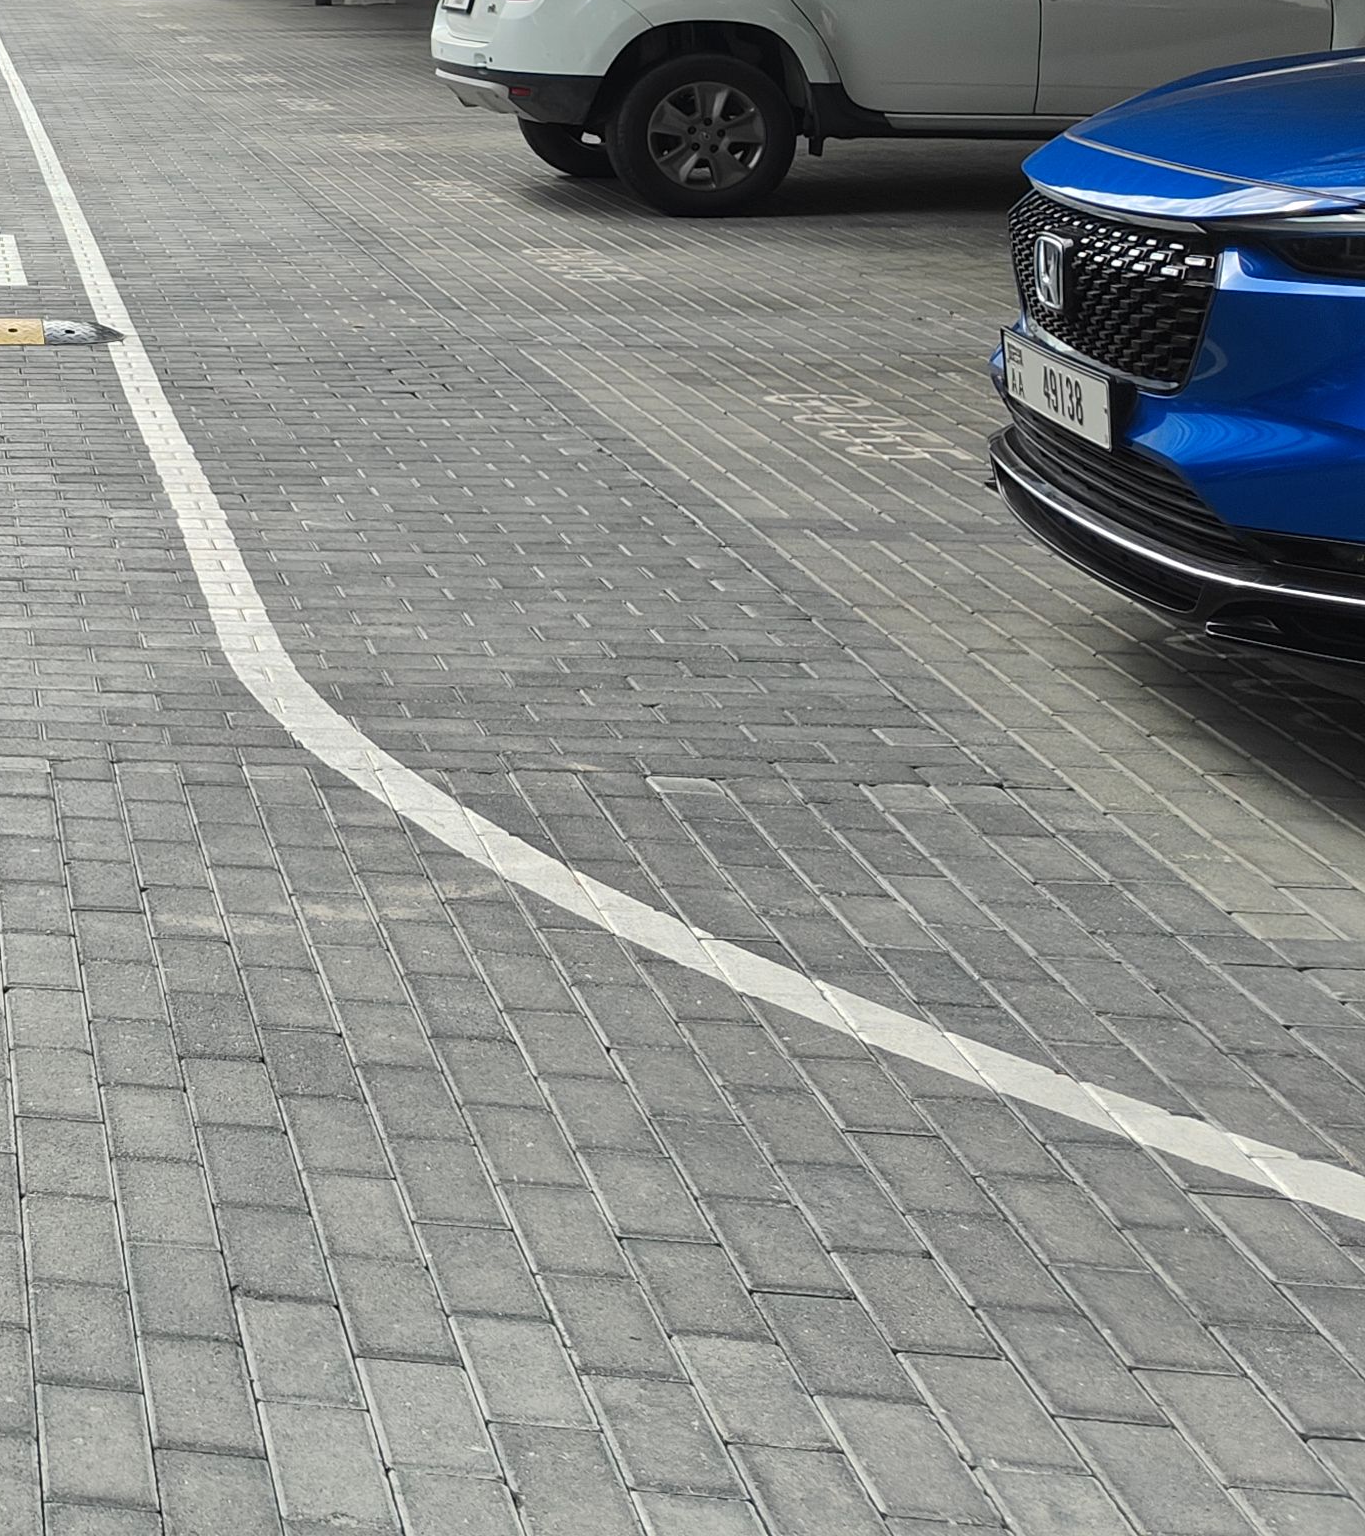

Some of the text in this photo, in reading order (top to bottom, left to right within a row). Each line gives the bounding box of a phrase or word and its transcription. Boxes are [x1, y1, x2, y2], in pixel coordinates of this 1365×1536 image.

[763, 393, 974, 460] G-055
[1011, 364, 1084, 427] AA 49138
